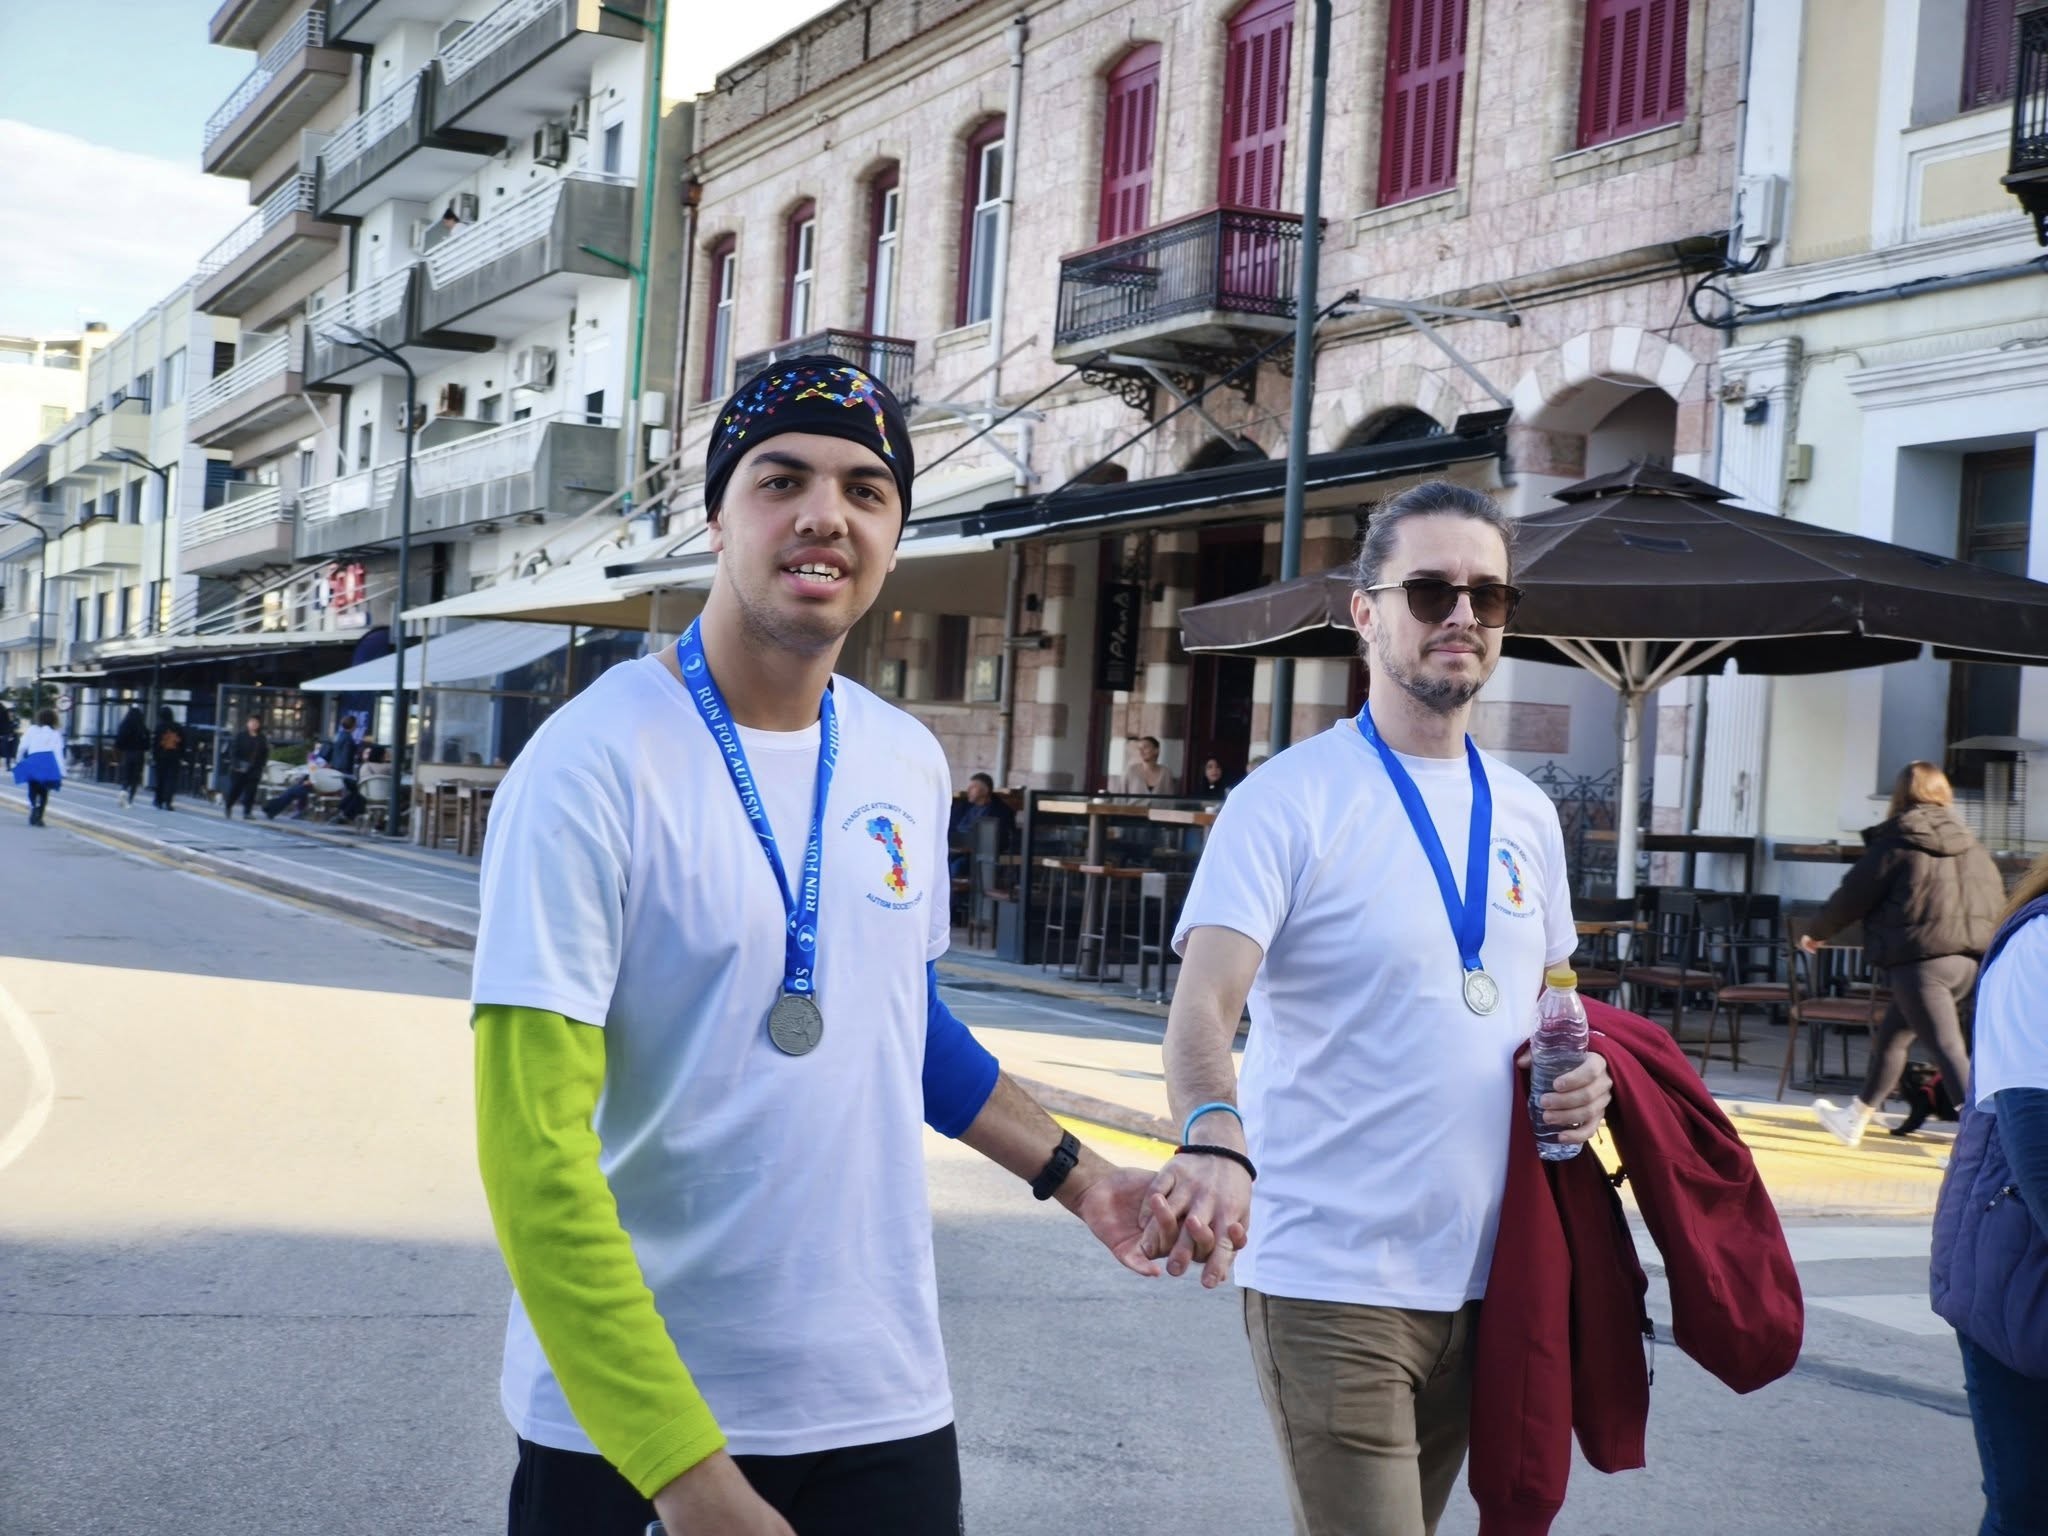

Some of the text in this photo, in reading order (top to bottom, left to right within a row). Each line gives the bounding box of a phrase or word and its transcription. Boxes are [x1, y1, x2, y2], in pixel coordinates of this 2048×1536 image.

[697, 686, 723, 721] RUN
[713, 722, 738, 754] FOR
[730, 757, 762, 820] AUTISM
[805, 876, 819, 912] RUN
